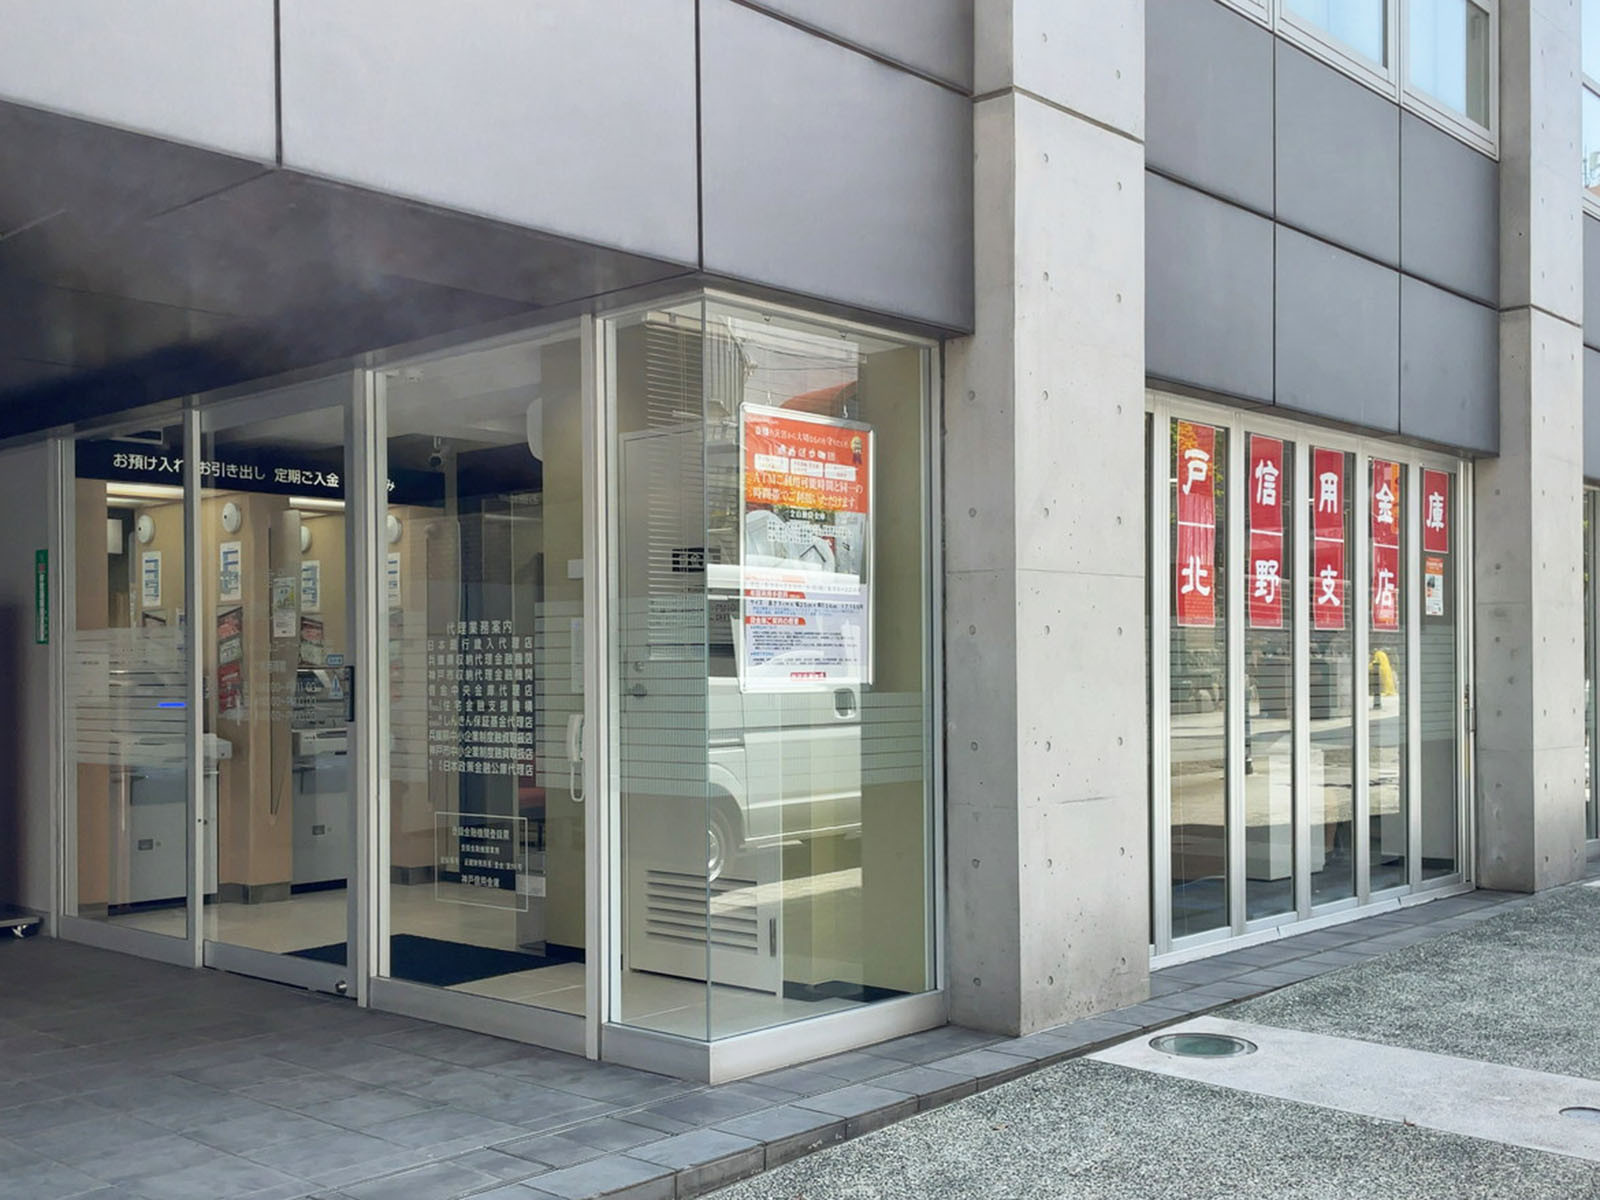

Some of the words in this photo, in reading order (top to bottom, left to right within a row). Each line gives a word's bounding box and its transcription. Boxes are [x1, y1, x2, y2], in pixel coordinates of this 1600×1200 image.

[200, 461, 265, 480] お引き出し
[274, 468, 339, 488] 定期ご入金
